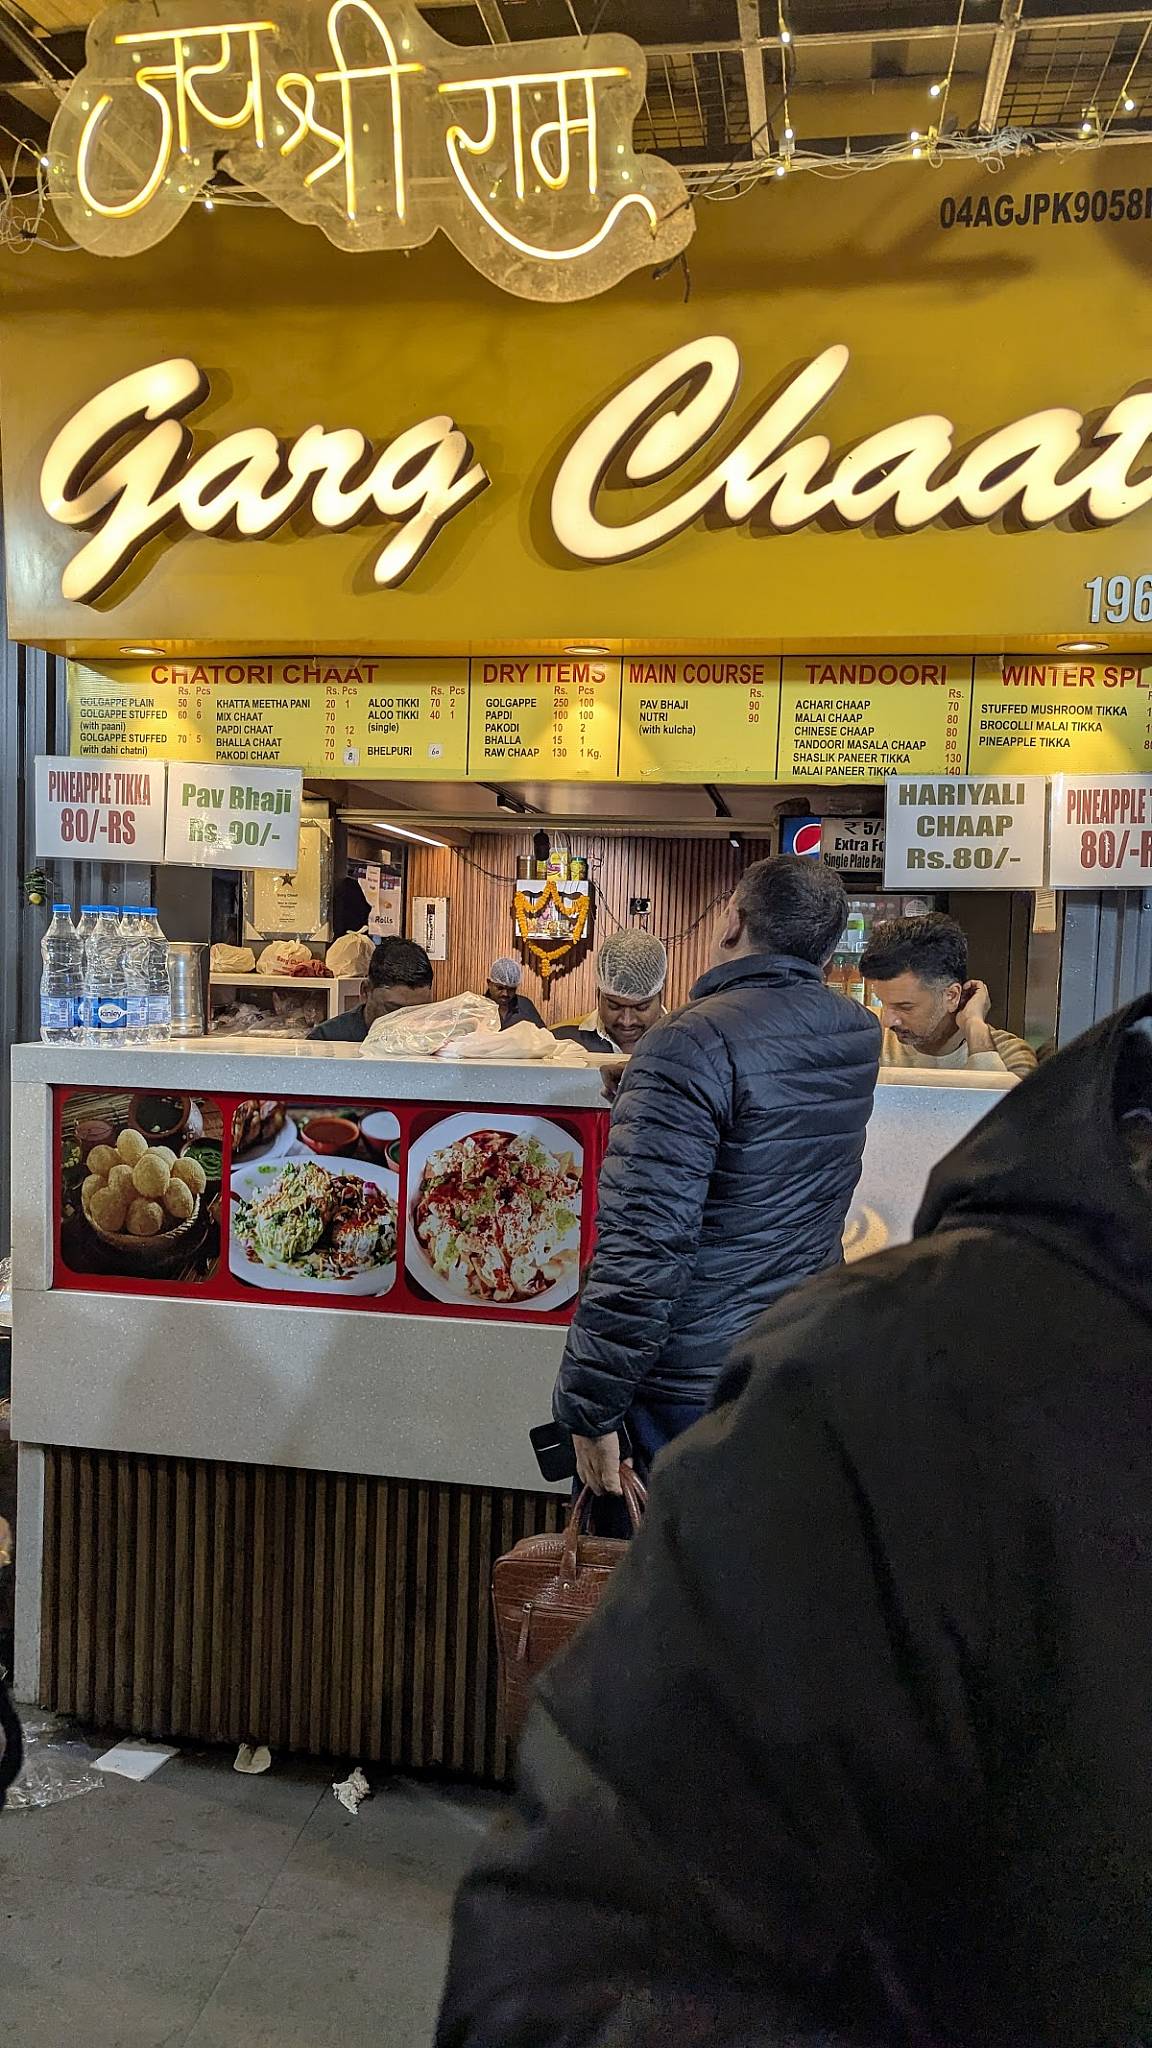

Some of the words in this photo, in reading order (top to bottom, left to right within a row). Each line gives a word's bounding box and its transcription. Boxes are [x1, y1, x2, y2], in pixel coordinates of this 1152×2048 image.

[437, 67, 657, 260] राम
[40, 357, 493, 601] Garg
[550, 334, 1152, 564] Chaat
[151, 664, 273, 685] CHATORI
[282, 664, 379, 685] CHAAT
[483, 664, 530, 683] DRY
[536, 664, 606, 683] ITEMS
[629, 664, 676, 683] MAIN
[683, 664, 764, 684] COURSE
[805, 664, 947, 686] TANDOORI
[1002, 666, 1096, 688] WINTER
[1103, 667, 1150, 689] SPL
[178, 686, 191, 696] Rs.
[195, 686, 211, 696] Pcs
[325, 686, 340, 696] Rs.
[342, 686, 358, 696] Pcs
[430, 686, 445, 695] Rs.
[449, 686, 466, 695] Pcs
[554, 686, 568, 695] Rs.
[578, 686, 594, 695] Pcs
[749, 688, 765, 698] Rs.
[949, 689, 965, 699] Rs.
[80, 698, 127, 708] GOLGAPPE
[129, 699, 155, 708] PLAIN
[178, 699, 188, 708] 50
[196, 699, 202, 708] 6
[216, 700, 251, 709] KHATTA
[252, 700, 288, 709] MEETHA
[290, 700, 311, 709] PANI
[325, 700, 336, 709] 20
[345, 700, 350, 709] 1
[368, 699, 394, 708] ALOO
[396, 699, 420, 708] TIKKI
[430, 699, 441, 708] 70
[450, 699, 455, 708] 2
[486, 699, 537, 708] GOLGAPPE
[553, 699, 569, 708] 250
[579, 699, 594, 708] 100
[640, 700, 658, 709] PAV
[660, 700, 689, 710] BHAJI
[749, 701, 760, 711] 90
[795, 700, 833, 710] ACHARI
[835, 701, 871, 710] CHAAP
[948, 702, 959, 711] 70
[80, 709, 127, 719] GOLGAPPE
[129, 710, 168, 719] STUFFED
[196, 711, 202, 720] 6
[368, 711, 394, 720] ALOO
[396, 711, 419, 720] TIKKI
[429, 711, 441, 720] 40
[450, 711, 454, 720] 1
[485, 711, 513, 720] PAPDI
[553, 711, 568, 720] 100
[579, 711, 594, 720] 100
[981, 704, 1028, 714] STUFFED
[1030, 705, 1093, 715] MUSHROOM
[1096, 706, 1128, 716] TIKKA
[216, 713, 232, 722] MIX
[233, 713, 263, 722] CHAAT
[325, 713, 336, 722] 70
[639, 712, 668, 722] NUTRI
[748, 713, 760, 723] 90
[795, 713, 826, 723] MALAI
[828, 714, 863, 723] CHAAP
[946, 715, 959, 725] 80
[80, 721, 100, 731] (with
[101, 722, 126, 733] paani)
[216, 726, 242, 735] PAPDI
[244, 726, 273, 735] CHAAT
[325, 726, 336, 735] 70
[345, 726, 355, 735] 12
[368, 722, 400, 734] (single)
[485, 724, 520, 733] PAKODI
[553, 724, 563, 733] 10
[580, 724, 586, 733] 2
[639, 725, 661, 736] (with
[663, 725, 696, 736] kulcha)
[794, 726, 837, 736] CHINESE
[840, 727, 875, 737] CHAAP
[946, 728, 958, 738] 80
[980, 721, 1033, 731] BROCOLLI
[1036, 722, 1069, 732] MALAI
[1071, 722, 1103, 733] TIKKA
[80, 733, 127, 743] GOLGAPPE
[129, 734, 168, 743] STUFFED
[178, 734, 187, 744] 70
[196, 735, 202, 744] 5
[216, 738, 251, 747] BHALLA
[252, 738, 282, 747] CHAAT
[325, 738, 335, 748] 70
[347, 739, 352, 748] 3
[484, 736, 522, 745] BHALLA
[552, 736, 563, 745] 15
[580, 736, 585, 745] 1
[979, 737, 1037, 747] PINEAPPLE
[1040, 738, 1071, 748] TIKKA
[793, 739, 845, 749] TANDOORI
[847, 740, 888, 750] MASALA
[891, 741, 927, 751] CHAAP
[945, 741, 957, 751] 80
[80, 745, 99, 756] (with
[101, 746, 119, 755] dahi
[120, 746, 148, 757] chatni)
[216, 751, 249, 760] PAKODI
[250, 751, 280, 760] CHAAT
[324, 751, 335, 761] 70
[367, 747, 413, 756] BHELPURI
[484, 748, 506, 757] RAW
[507, 748, 540, 757] CHAAP
[552, 748, 568, 757] 130
[580, 748, 584, 757] 1
[586, 748, 602, 760] Kg.
[793, 753, 835, 763] SHASLIK
[837, 753, 878, 763] PANEER
[880, 754, 911, 764] TIKKA
[945, 753, 962, 763] 130
[792, 766, 823, 776] MALAI
[825, 766, 865, 776] PANEER
[867, 766, 898, 777] TIKKA
[944, 766, 961, 776] 140
[48, 770, 112, 804] PINEAPPLE
[113, 773, 151, 806] TIKKA
[182, 783, 225, 807] Pav
[229, 786, 292, 816] Bhaji
[899, 783, 1025, 806] HARIYALI
[1066, 789, 1146, 825] PINEAPPLE
[60, 808, 136, 845] 80/-RS
[916, 815, 1014, 837] CHAAP
[229, 820, 281, 847] 90/-
[835, 837, 869, 852] Extra
[823, 852, 849, 869] Single
[849, 853, 869, 869] Plate
[871, 854, 884, 869] Pa
[906, 847, 1021, 870] Rs.80/-
